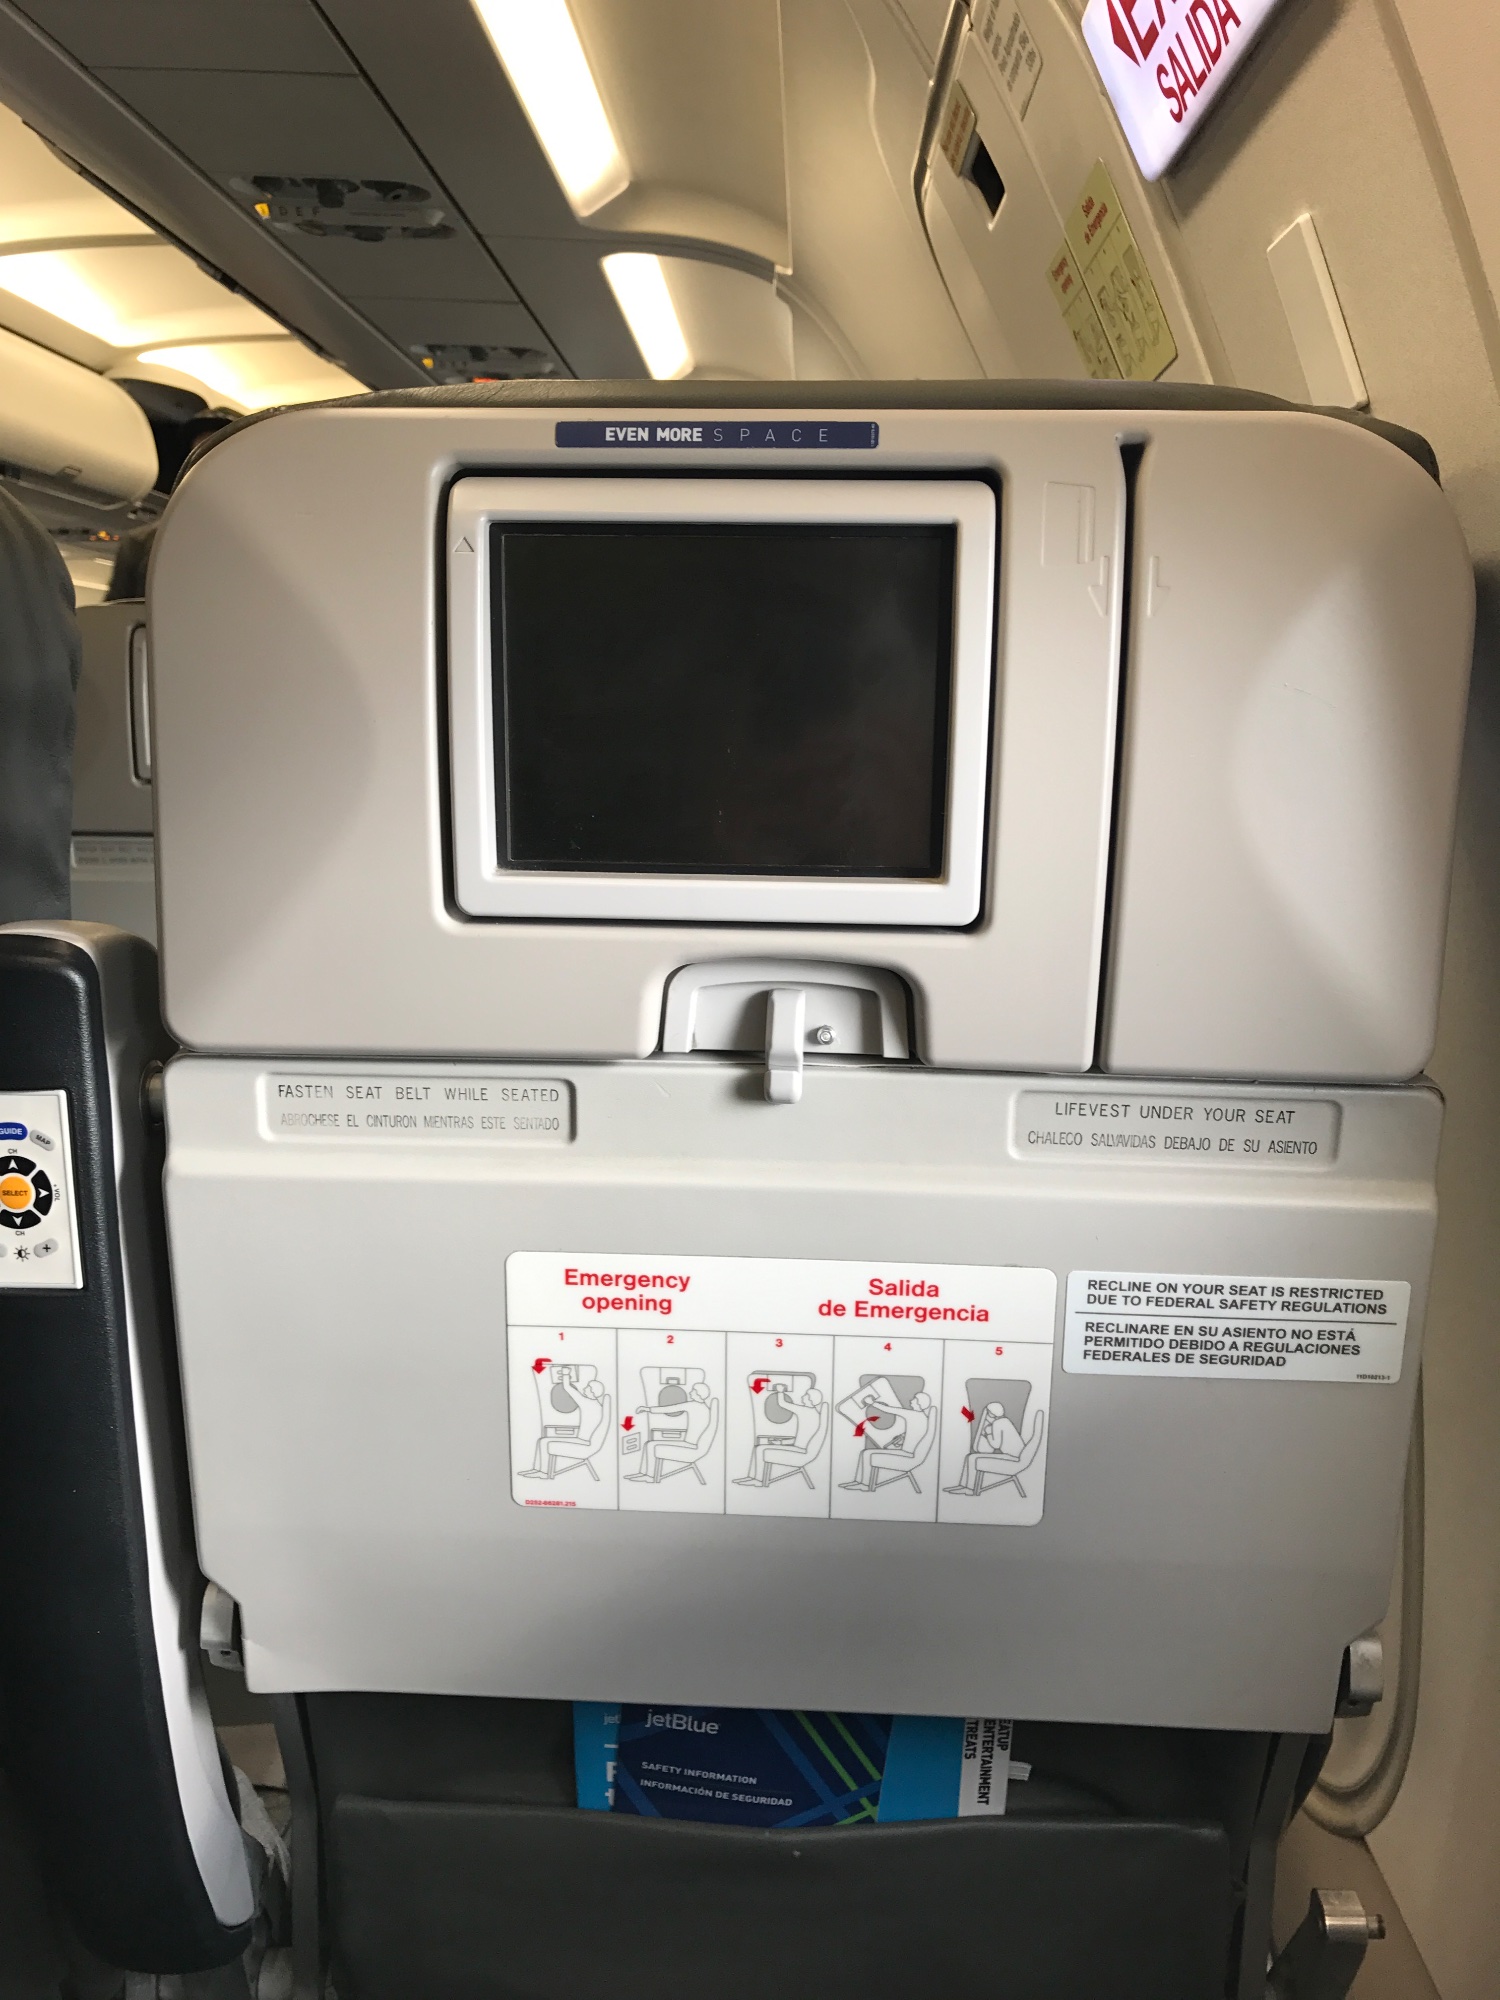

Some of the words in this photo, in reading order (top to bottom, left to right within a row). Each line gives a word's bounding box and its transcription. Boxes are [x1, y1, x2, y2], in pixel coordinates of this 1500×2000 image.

[1156, 0, 1242, 123] SALIDA
[605, 427, 649, 442] EVEN
[656, 427, 703, 442] MORE
[713, 428, 828, 442] SPACE
[278, 1085, 333, 1099] FASTEN
[346, 1086, 382, 1100] SEAT
[395, 1086, 431, 1100] BELT
[444, 1087, 488, 1101] WHILE
[501, 1088, 559, 1102] SEATED
[281, 1113, 340, 1127] ABROCHESE
[347, 1114, 359, 1128] EL
[366, 1114, 417, 1129] CINTURON
[423, 1115, 474, 1129] MIENTRAS
[481, 1116, 506, 1130] ESTE
[513, 1117, 560, 1131] SENTADO
[1055, 1102, 1130, 1117] LIFEVEST
[1139, 1105, 1193, 1120] UNDER
[1203, 1107, 1246, 1123] YOUR
[1254, 1109, 1295, 1124] SEAT
[35, 1134, 51, 1146] MAP
[1028, 1130, 1082, 1146] CHALECO
[1090, 1132, 1156, 1149] SALVAVIDAS
[1164, 1135, 1211, 1151] DEBAJO
[1218, 1137, 1235, 1152] DE
[1243, 1139, 1260, 1153] SU
[1268, 1139, 1318, 1155] ASIENTO
[564, 1269, 691, 1292] Emergency
[868, 1278, 939, 1298] Salida
[1087, 1279, 1152, 1293] RECLINE
[1156, 1282, 1178, 1295] ON
[1182, 1282, 1225, 1296] YOUR
[1229, 1284, 1268, 1298] SEAT
[1271, 1286, 1285, 1298] IS
[1289, 1286, 1384, 1301] RESTRICTED
[582, 1294, 672, 1315] opening
[818, 1300, 846, 1317] de
[854, 1301, 989, 1323] Emergencia
[1086, 1293, 1117, 1306] DUE
[1121, 1294, 1142, 1307] TO
[1145, 1295, 1215, 1310] FEDERAL
[1218, 1298, 1277, 1312] SAFETY
[1280, 1300, 1388, 1316] REGULATIONS
[558, 1332, 565, 1341] 1
[666, 1335, 674, 1344] 2
[1084, 1321, 1170, 1336] RECLINARE
[1174, 1325, 1194, 1337] EN
[1197, 1325, 1219, 1338] SU
[1221, 1326, 1287, 1340] ASIENTO
[1291, 1328, 1313, 1341] NO
[1317, 1327, 1356, 1342] ESTÁ
[775, 1338, 783, 1348] 3
[884, 1342, 892, 1351] 4
[995, 1347, 1003, 1356] 5
[1084, 1336, 1165, 1350] PERMITIDO
[1169, 1338, 1225, 1352] DEBIDO
[1228, 1340, 1239, 1352] A
[1243, 1341, 1361, 1356] REGULACIONES
[1083, 1350, 1170, 1364] FEDERALES
[1174, 1352, 1194, 1365] DE
[1198, 1353, 1287, 1368] SEGURIDAD
[645, 1709, 719, 1735] jetBlue
[964, 1719, 979, 1760] TREATS
[977, 1719, 997, 1805] ENTERTAINMENT
[641, 1761, 682, 1775] SAFETY
[684, 1768, 757, 1785] INFORMATION
[640, 1778, 713, 1798] INFORMACIÓN
[715, 1790, 729, 1800] DE
[731, 1793, 793, 1807] SEGURIDAD
